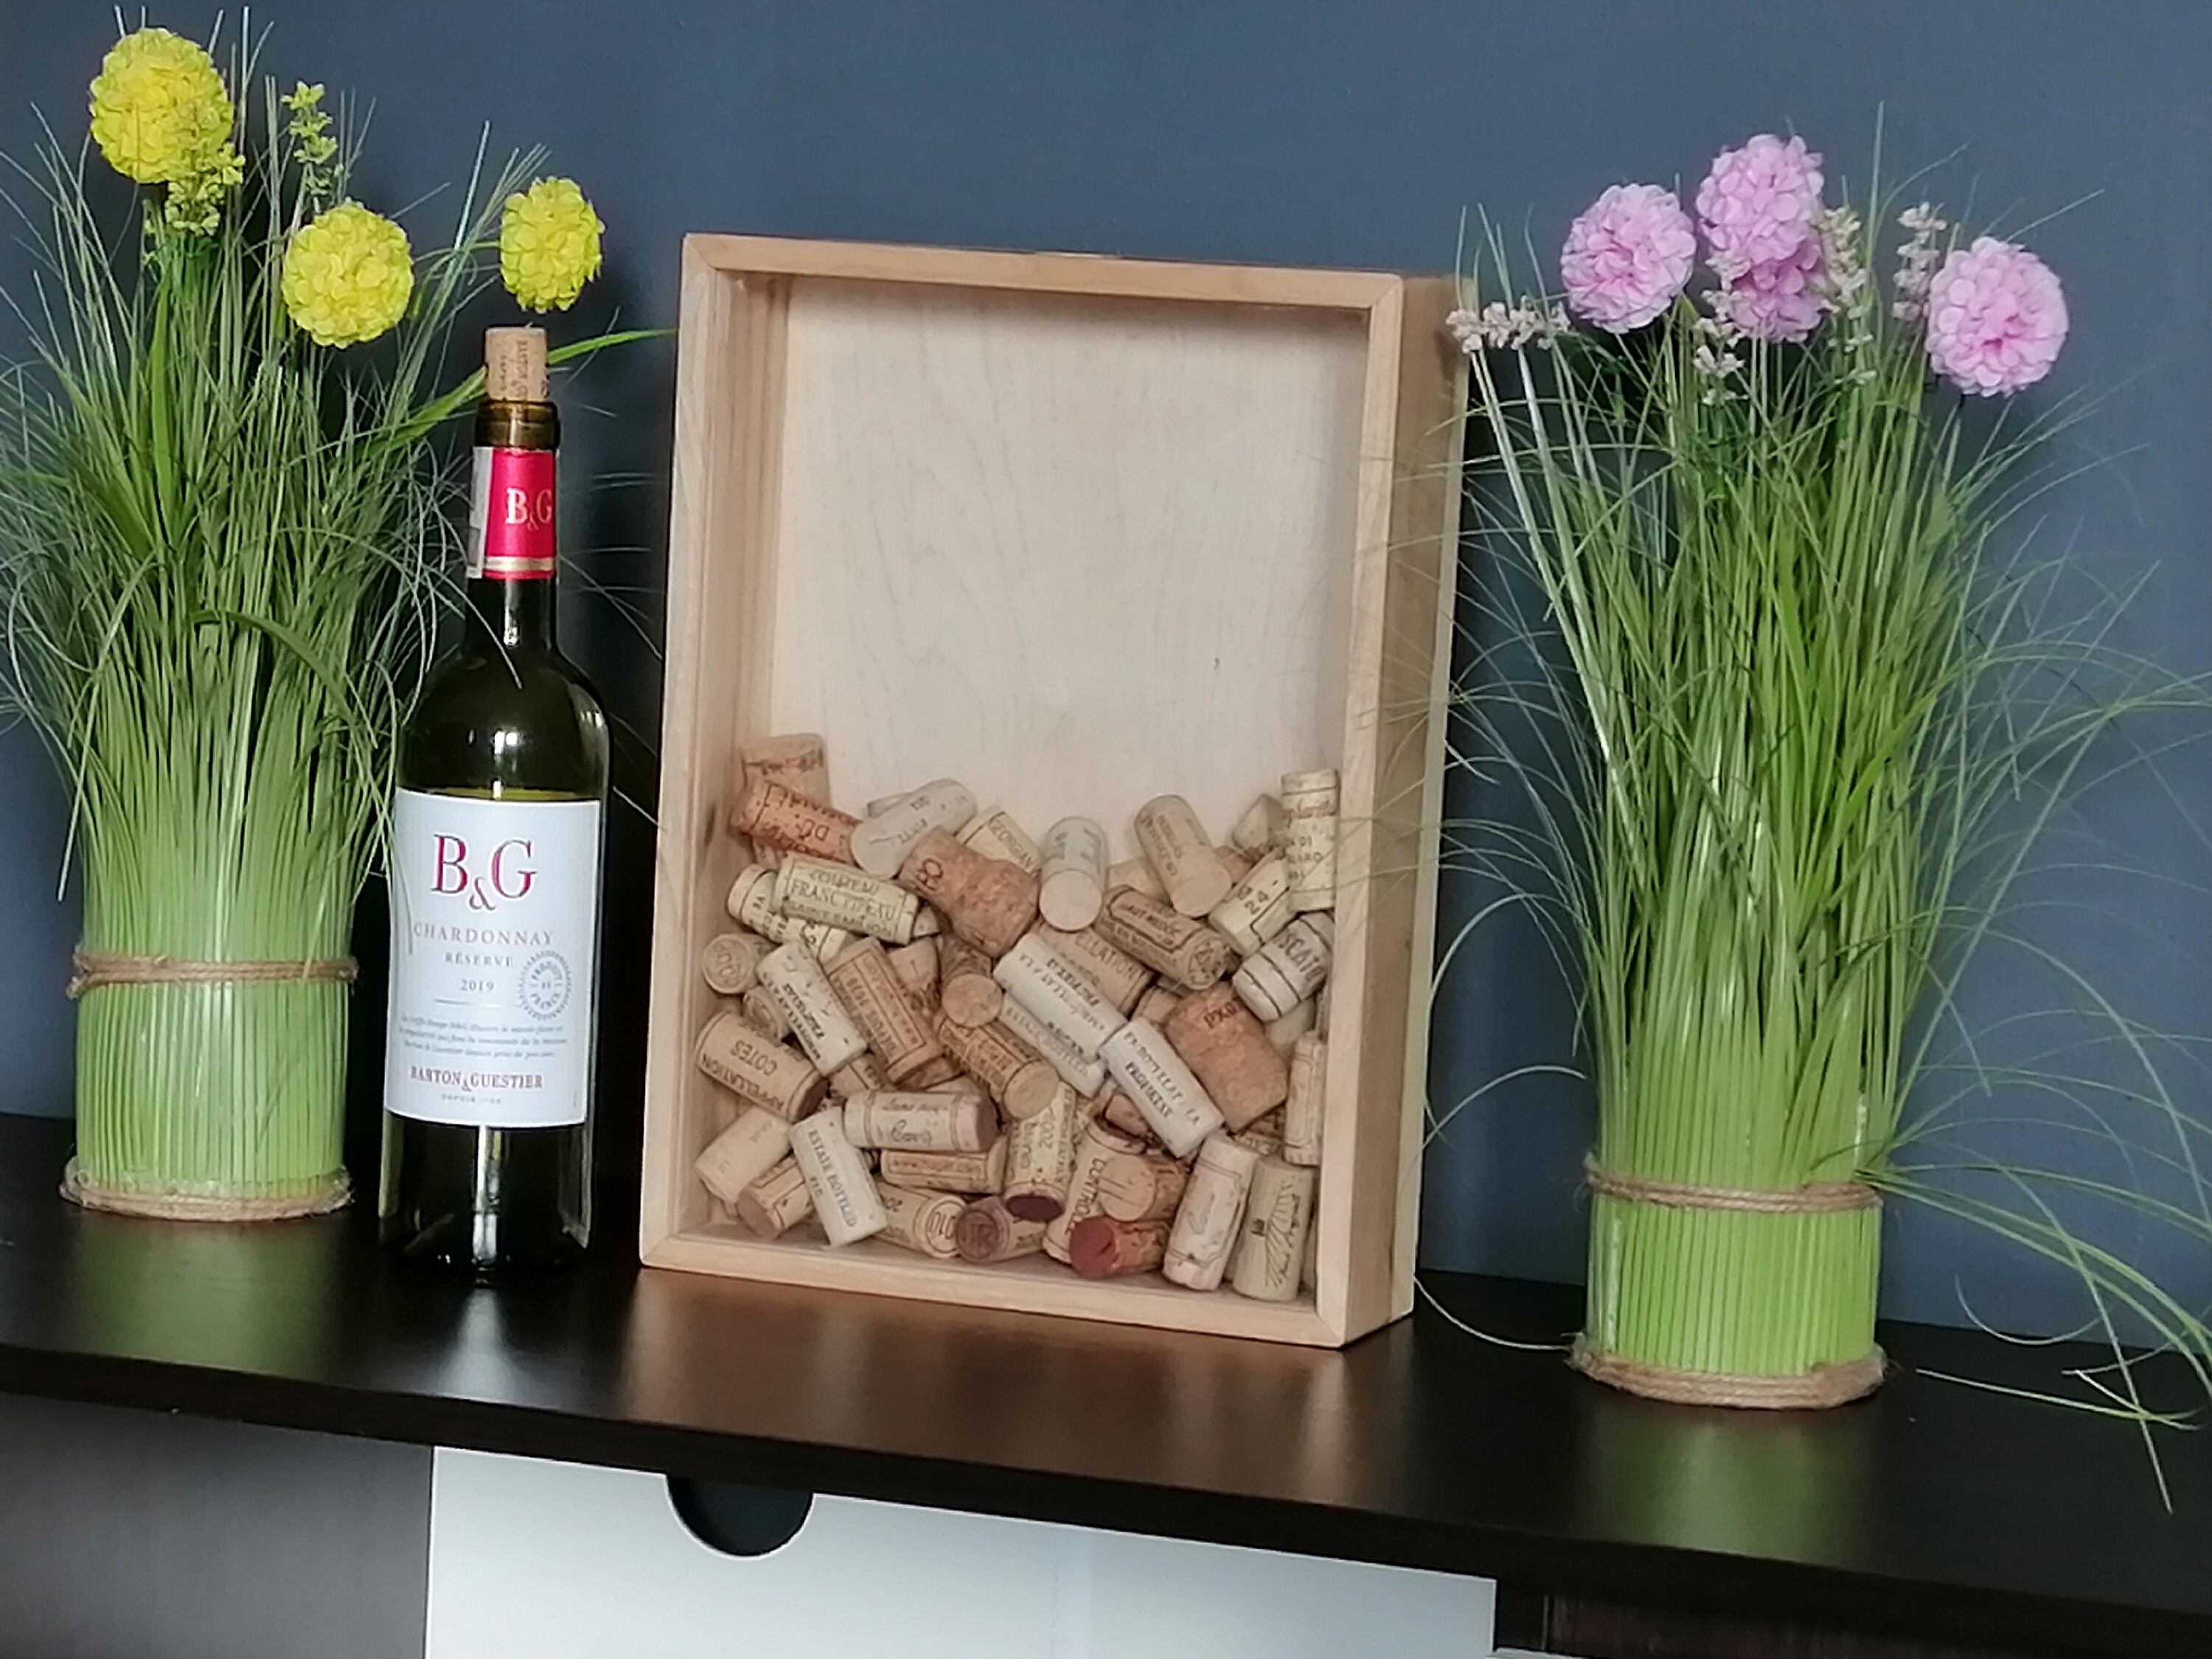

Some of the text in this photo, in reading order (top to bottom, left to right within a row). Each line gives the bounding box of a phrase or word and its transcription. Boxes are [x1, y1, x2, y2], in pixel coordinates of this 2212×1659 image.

[431, 834, 538, 911] B&G
[414, 922, 553, 945] CHARDONNAY
[445, 952, 513, 967] RÉSERVE
[460, 979, 494, 992] 2019
[728, 1037, 781, 1079] COTES
[807, 1128, 833, 1171] ESTATE
